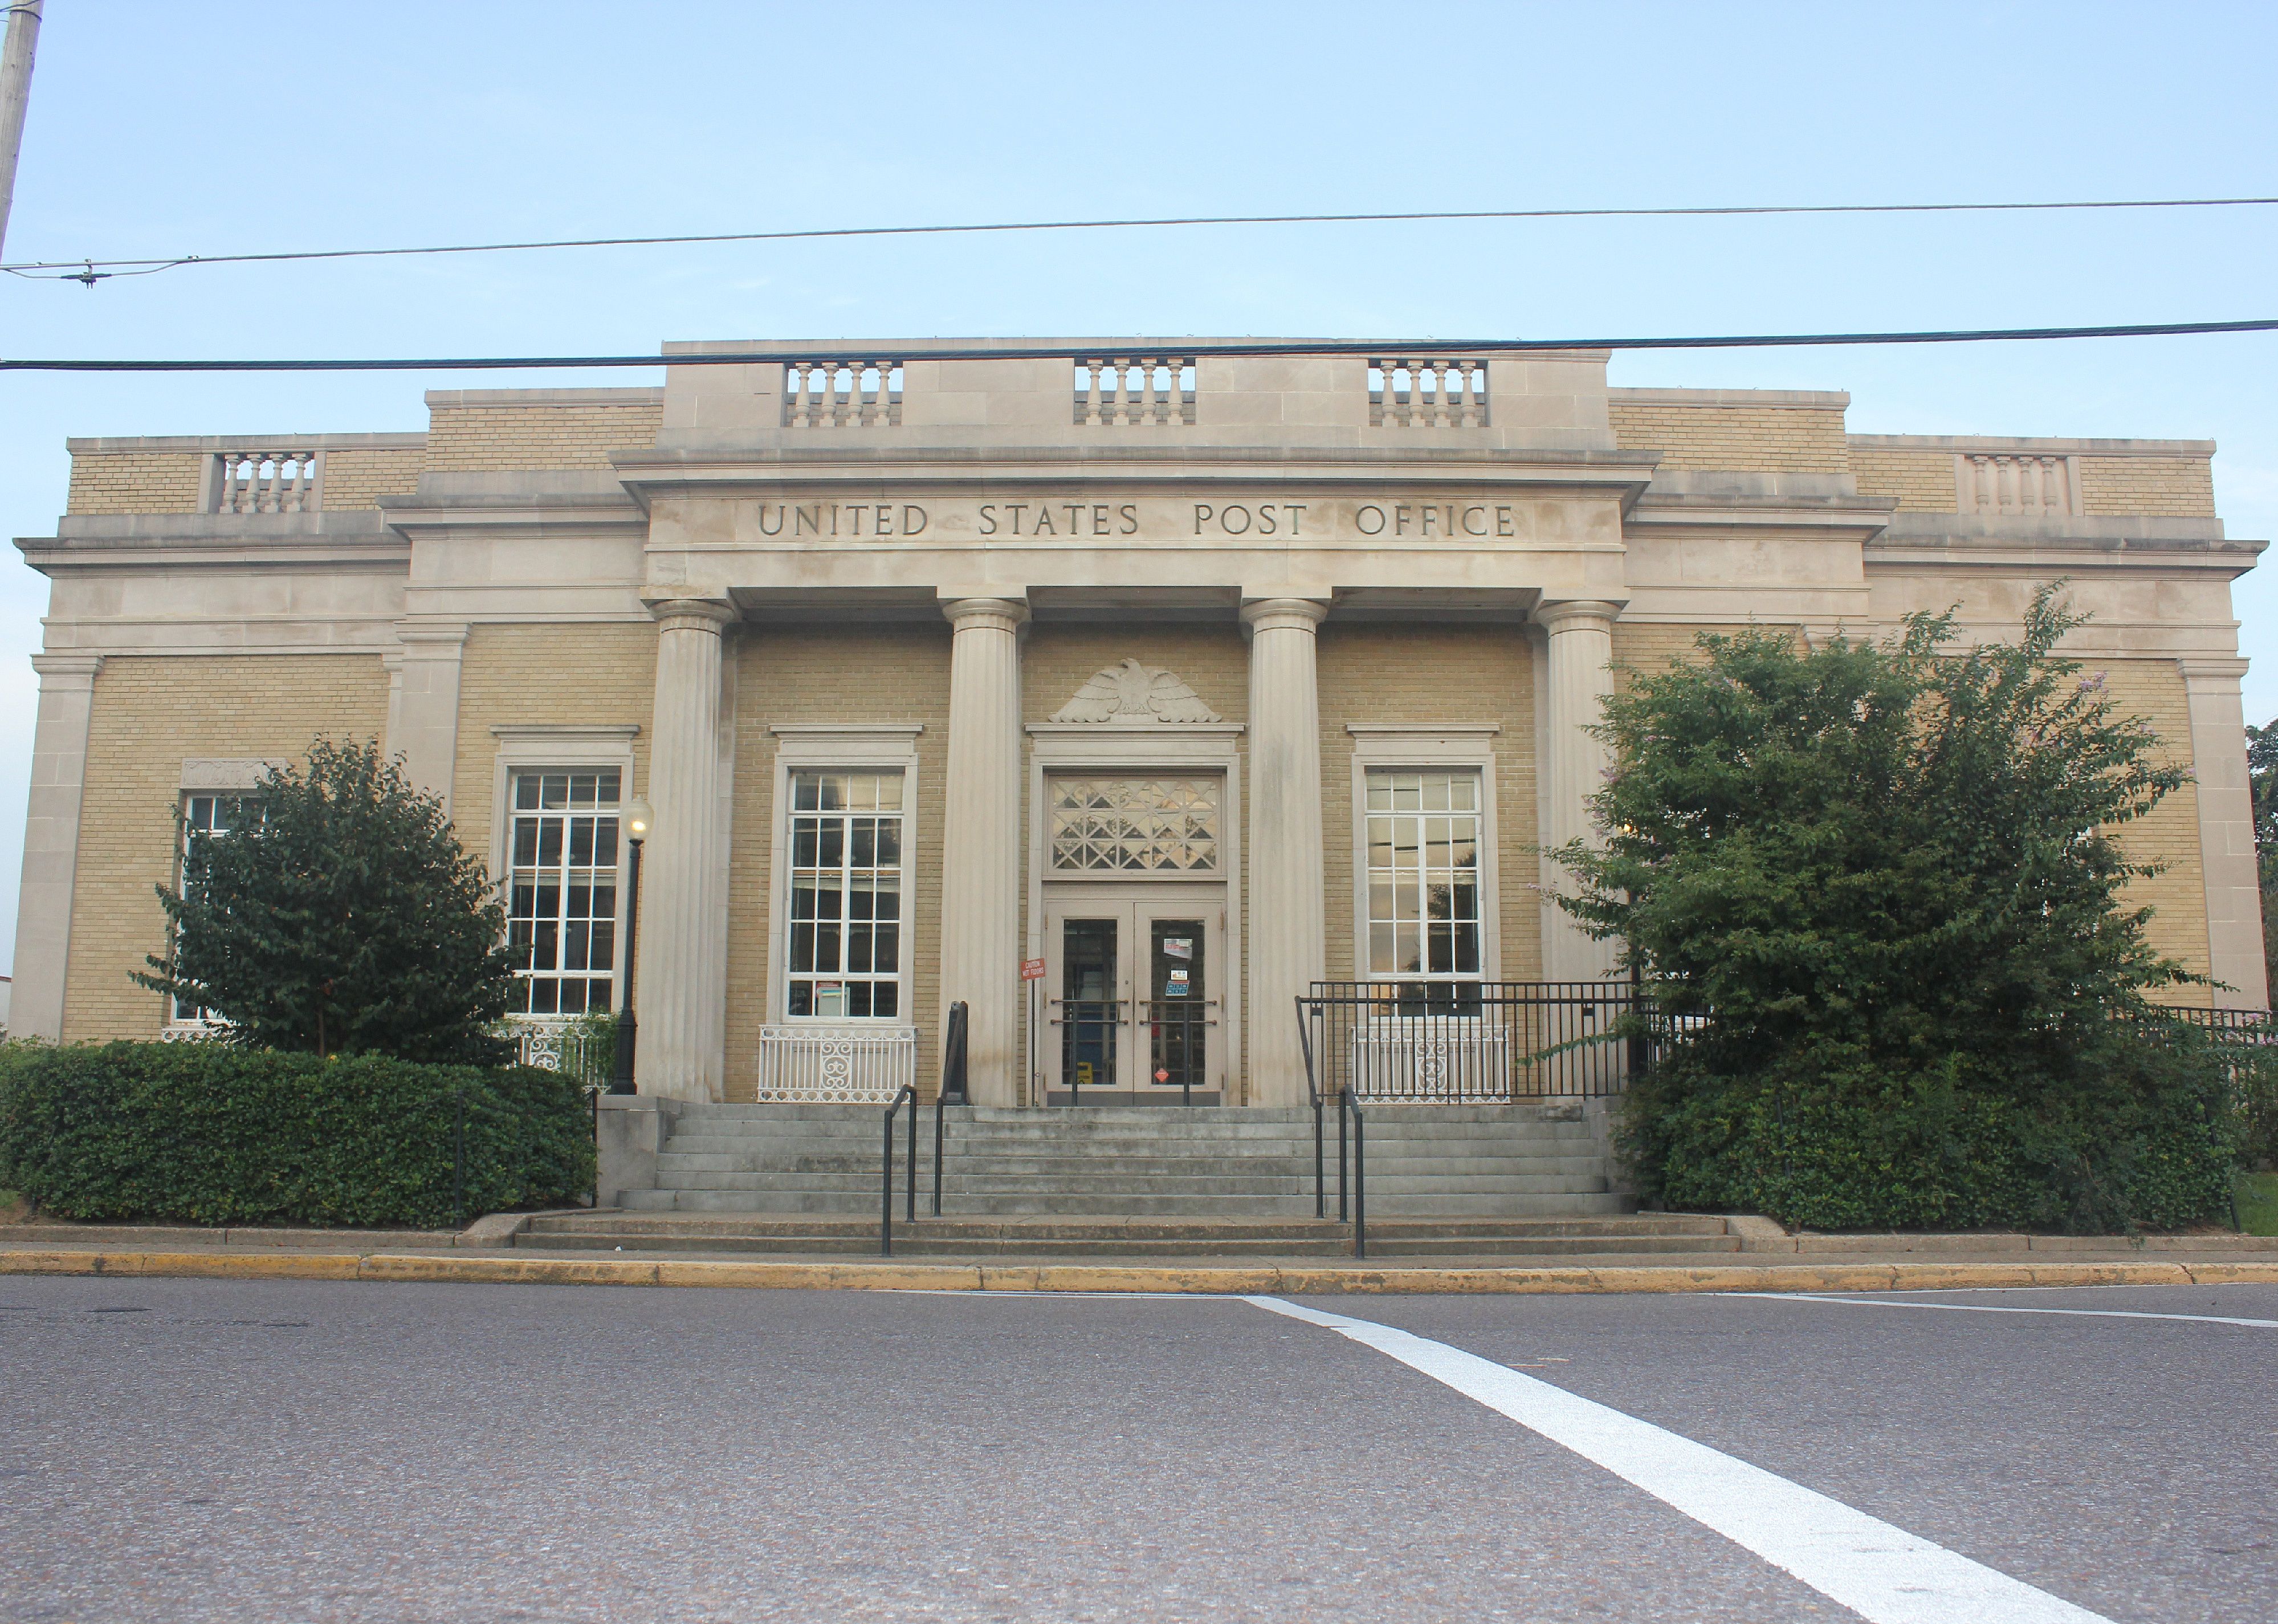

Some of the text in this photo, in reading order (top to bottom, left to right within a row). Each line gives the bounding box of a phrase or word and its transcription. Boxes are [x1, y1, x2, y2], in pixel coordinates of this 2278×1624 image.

[758, 504, 1515, 536] UNITED STATES POST OFFICE
[1025, 960, 1040, 969] CAUTION
